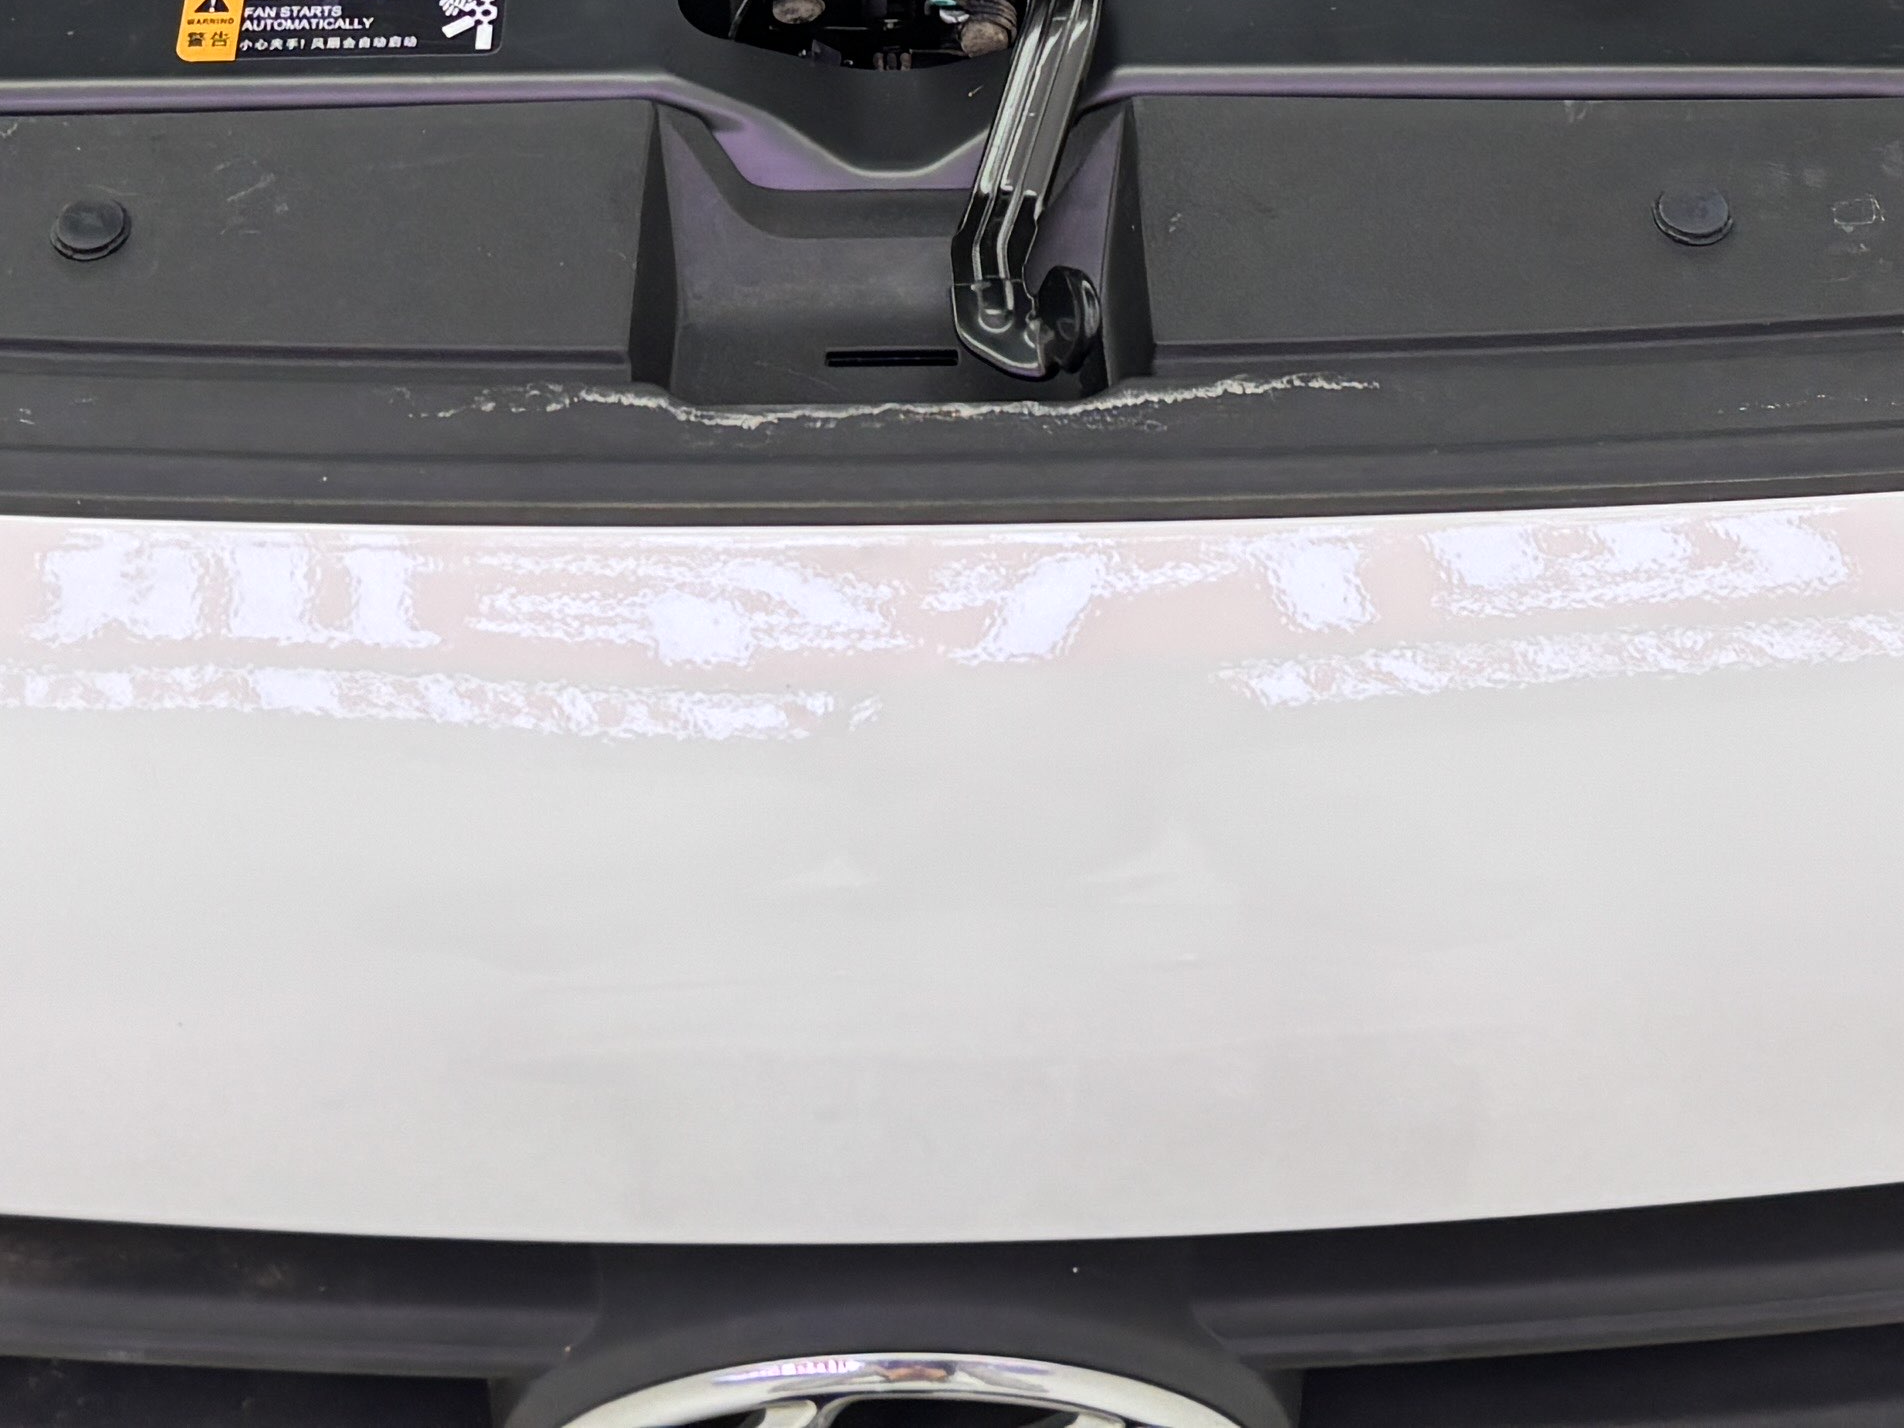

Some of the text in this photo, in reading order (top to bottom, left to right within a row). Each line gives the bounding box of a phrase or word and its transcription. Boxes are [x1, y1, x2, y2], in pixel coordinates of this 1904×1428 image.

[243, 5, 343, 19] FAN STARTS
[187, 16, 235, 26] WARNING
[241, 17, 376, 32] AUTOMATICALLY
[187, 31, 230, 48] 警告
